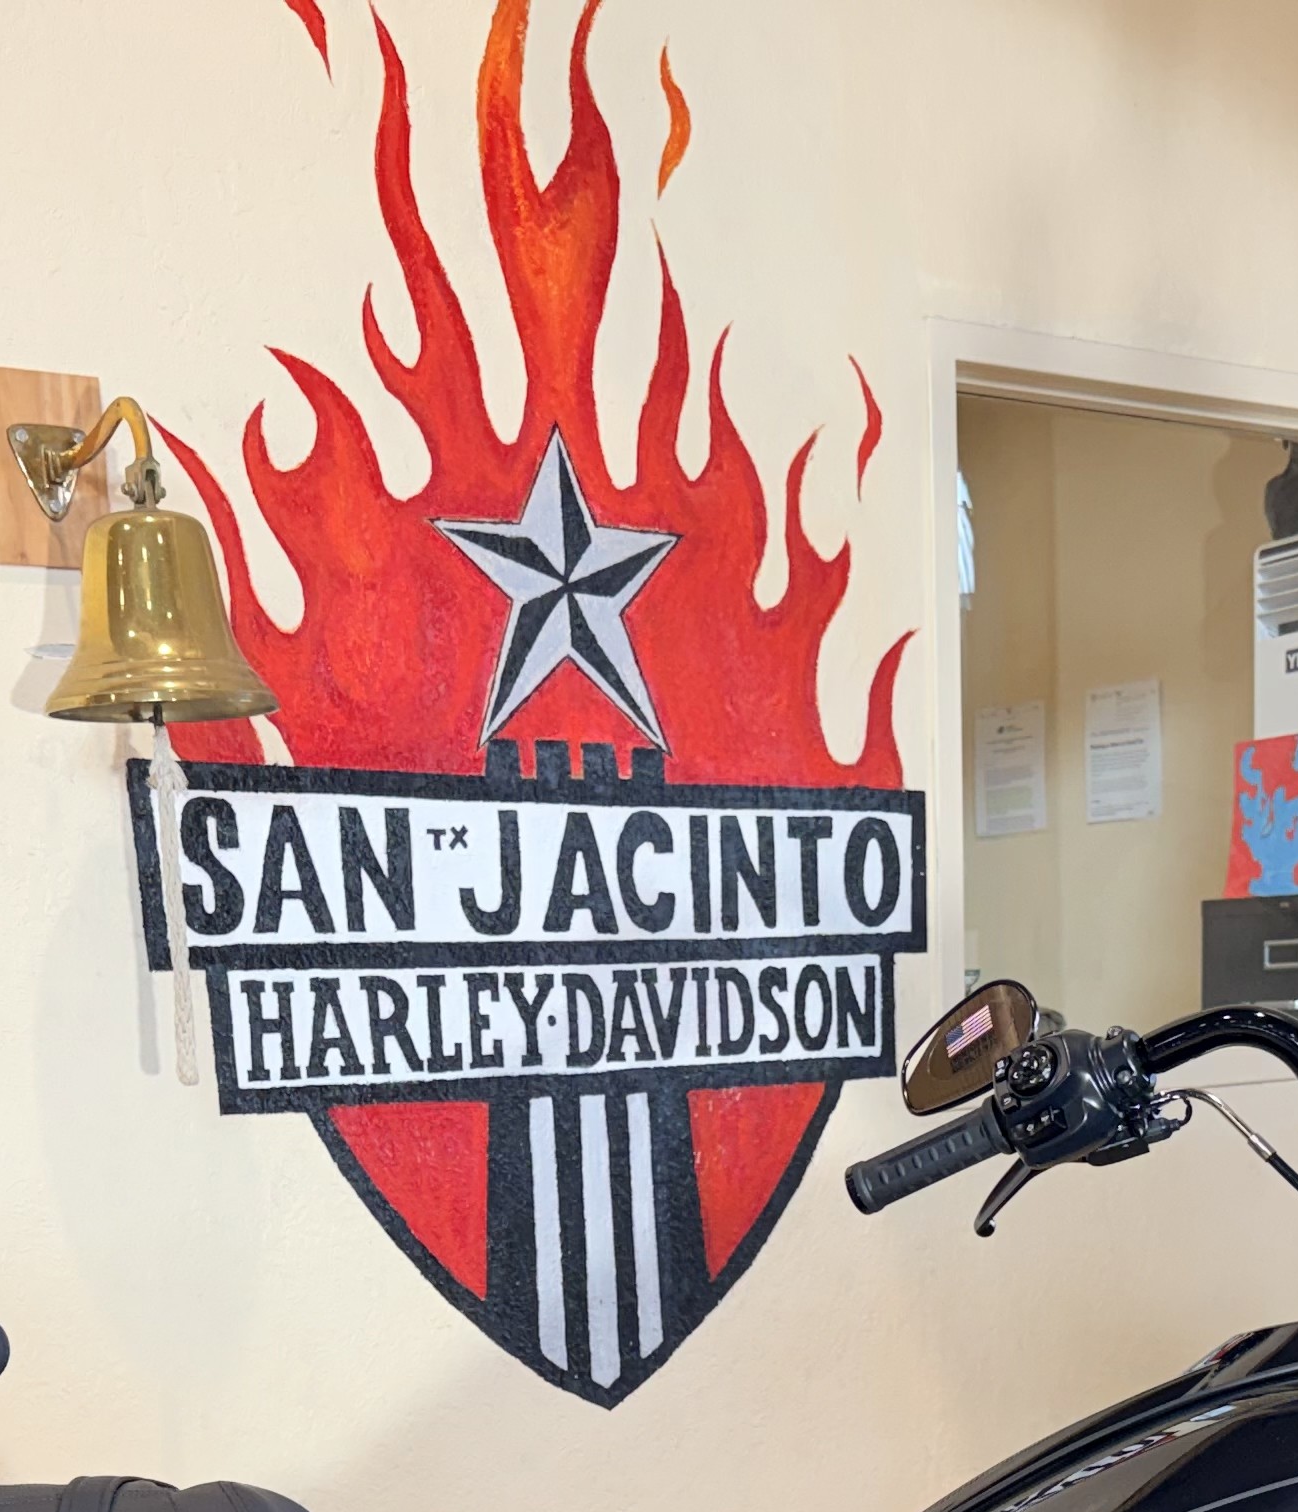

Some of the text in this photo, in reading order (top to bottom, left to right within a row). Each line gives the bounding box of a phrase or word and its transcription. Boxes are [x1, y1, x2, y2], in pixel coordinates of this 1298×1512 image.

[180, 796, 902, 937] SAN TX JACINTO
